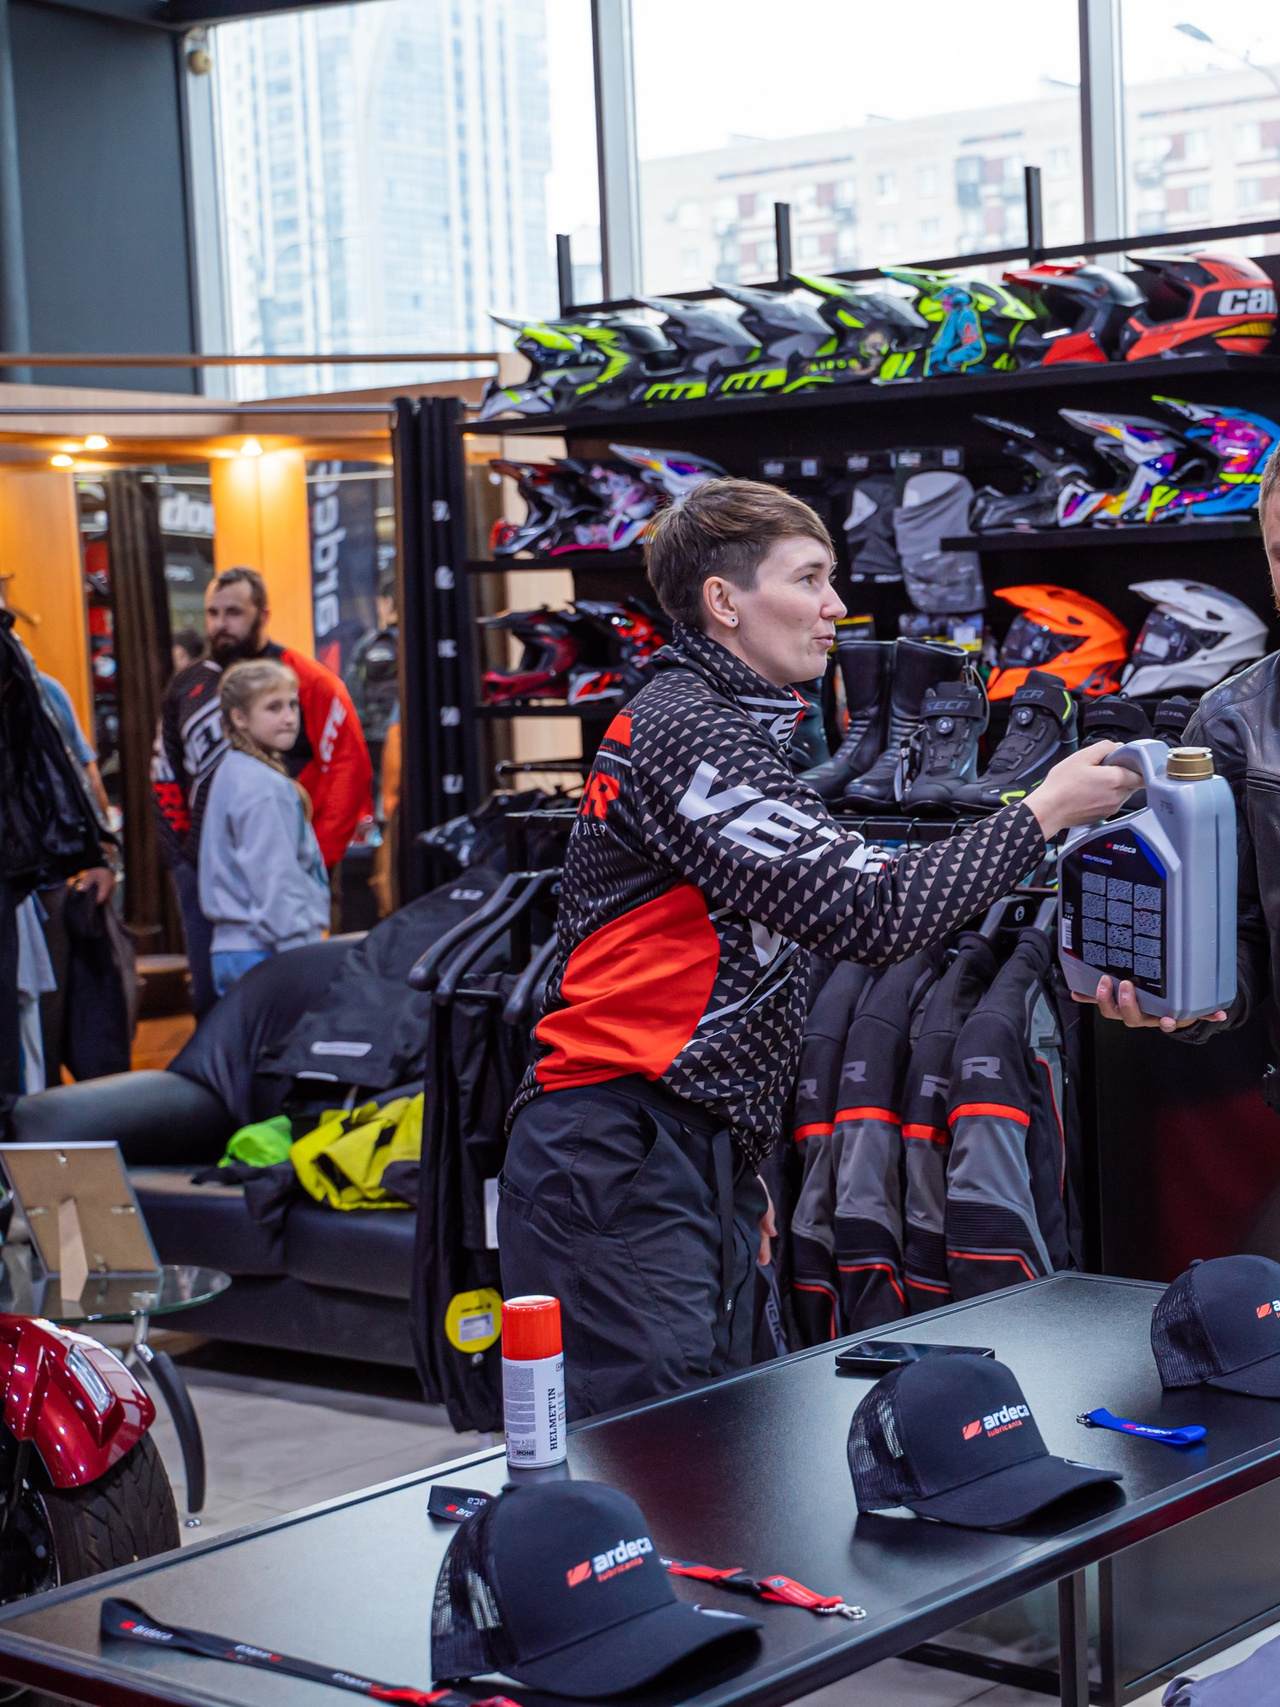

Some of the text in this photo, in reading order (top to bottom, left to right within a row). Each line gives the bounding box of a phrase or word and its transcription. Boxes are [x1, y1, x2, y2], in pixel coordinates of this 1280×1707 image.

[924, 700, 971, 713] SECA
[547, 1387, 558, 1451] HELMET'IN
[983, 1403, 1031, 1431] ardeca
[987, 1419, 1023, 1438] lubricants
[593, 1536, 654, 1573] ardeca
[597, 1557, 643, 1583] lubricants
